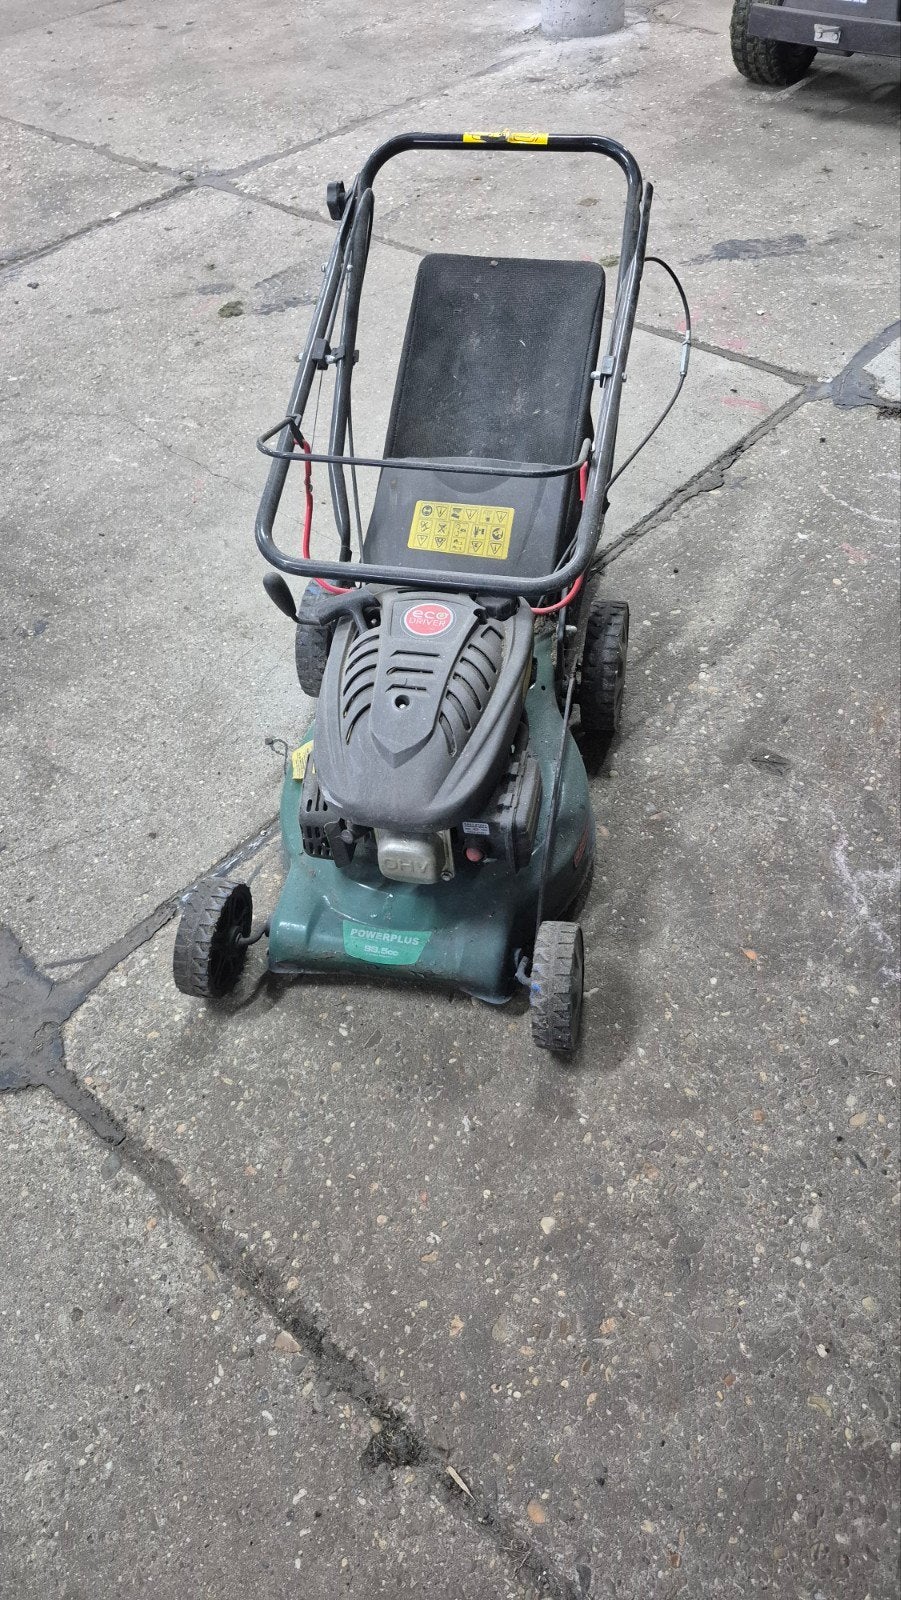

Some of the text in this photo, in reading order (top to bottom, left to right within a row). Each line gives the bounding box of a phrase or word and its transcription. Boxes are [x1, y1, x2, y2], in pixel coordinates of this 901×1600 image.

[412, 609, 449, 620] eco
[409, 617, 446, 627] DRIVER
[350, 928, 420, 946] POWERPLUS
